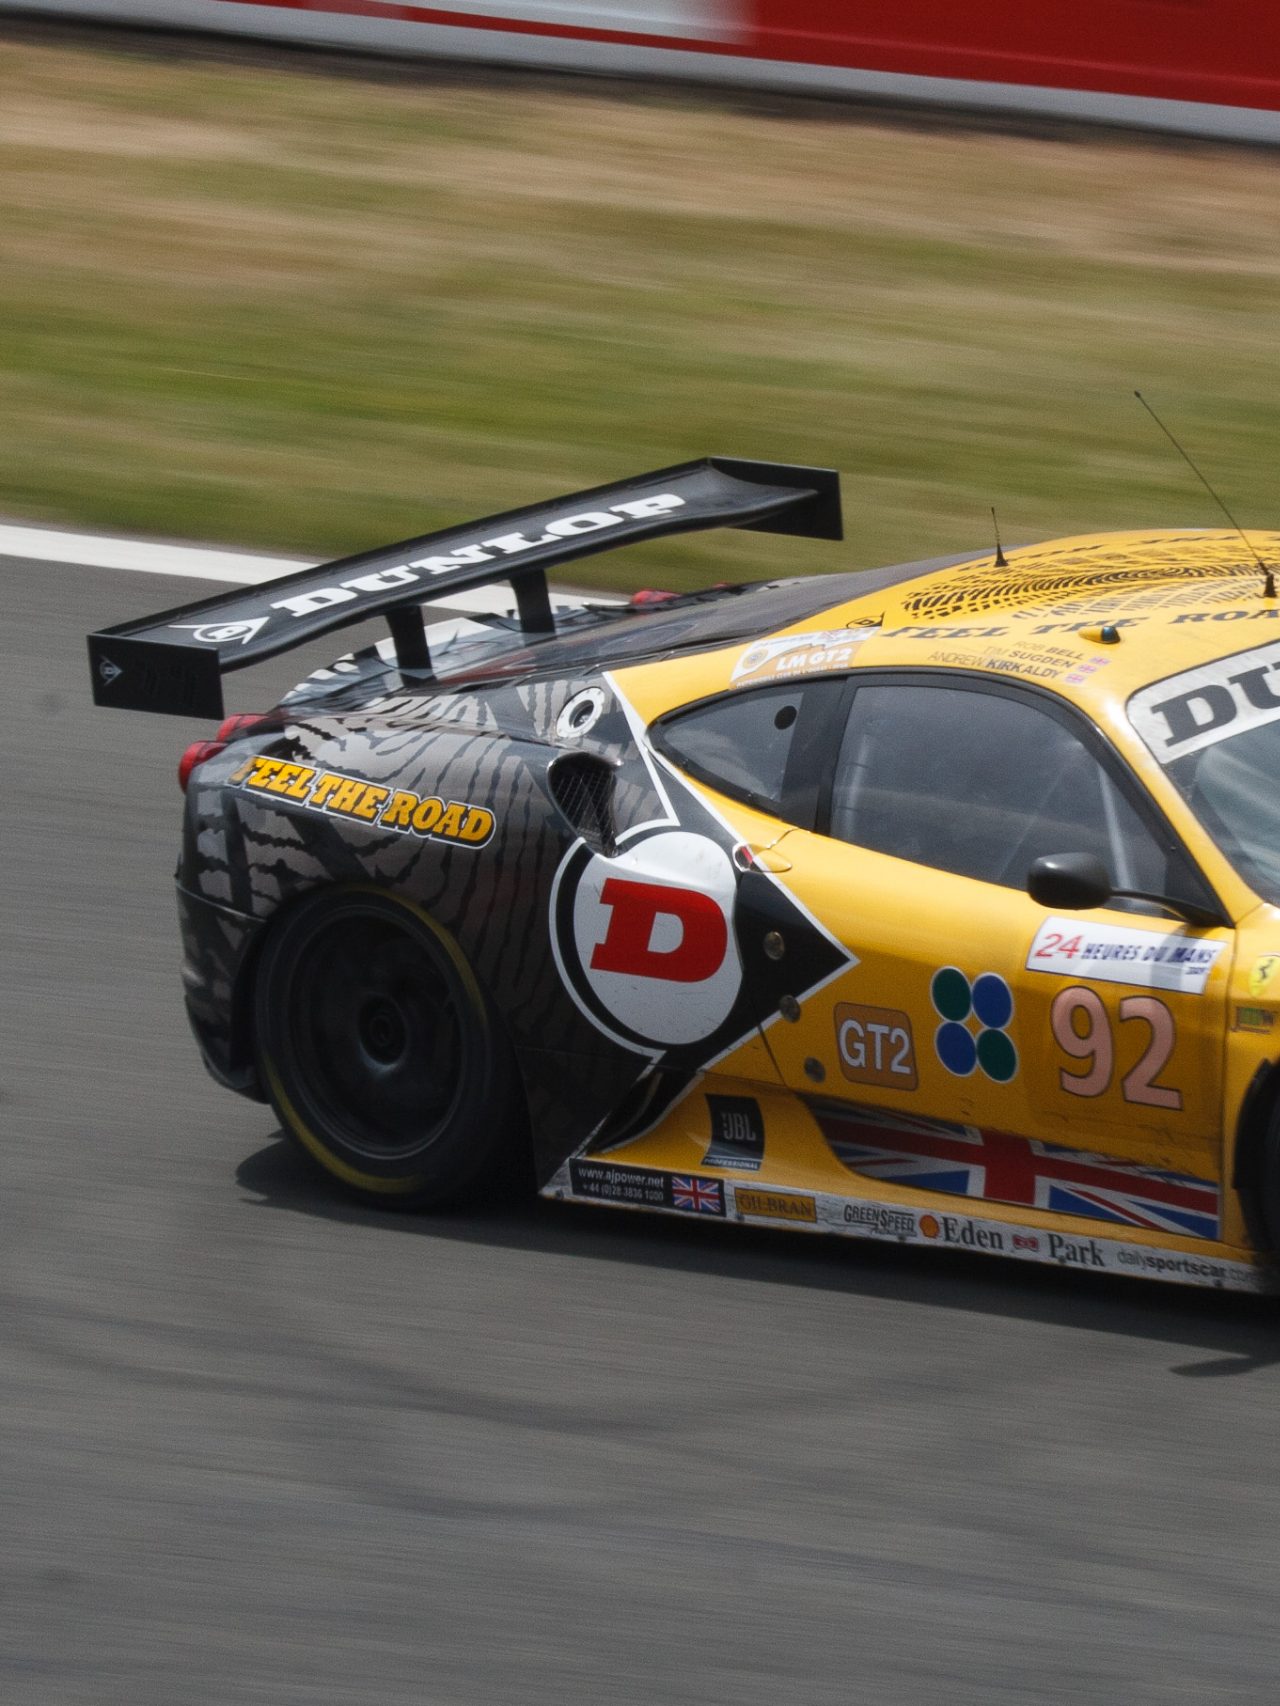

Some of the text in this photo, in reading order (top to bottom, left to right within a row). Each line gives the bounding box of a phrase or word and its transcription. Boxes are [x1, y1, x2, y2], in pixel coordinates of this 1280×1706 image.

[271, 493, 686, 618] DUNLOP
[881, 626, 1010, 639] FEEL
[776, 648, 854, 672] LM GT2
[927, 650, 1062, 680] ANDREW KIRKALDY
[1009, 649, 1079, 670] SUGDEN
[1044, 645, 1085, 660] BELL
[228, 756, 494, 842] FEEL THE ROAD
[1034, 933, 1217, 964] 24 HEURES DU MANS
[838, 1019, 912, 1075] GT2
[1050, 985, 1184, 1112] 92
[578, 1165, 665, 1188] www.ajpower.net
[941, 1216, 1105, 1268] Eden Park
